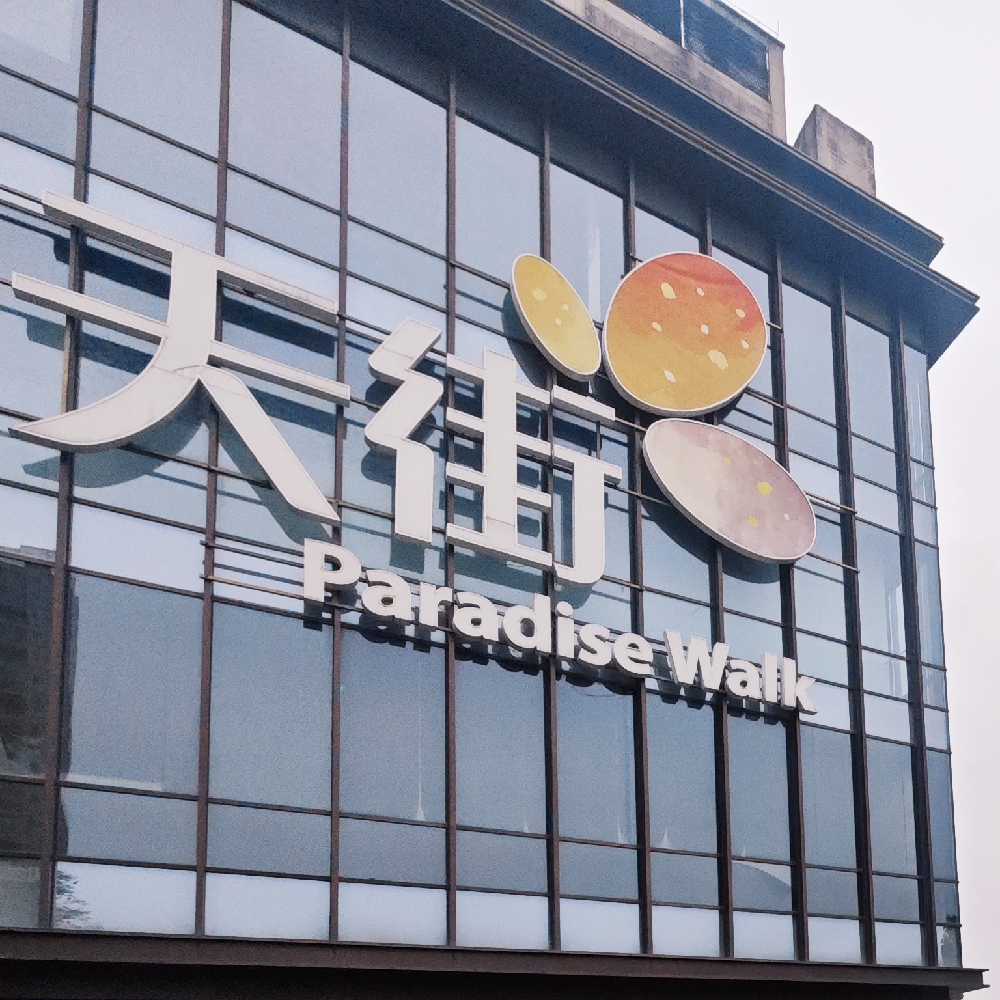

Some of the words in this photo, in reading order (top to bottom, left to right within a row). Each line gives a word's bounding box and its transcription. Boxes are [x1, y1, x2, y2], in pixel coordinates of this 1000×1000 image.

[9, 190, 622, 586] 天街
[303, 537, 655, 678] Paradise
[663, 628, 817, 716] Walk
